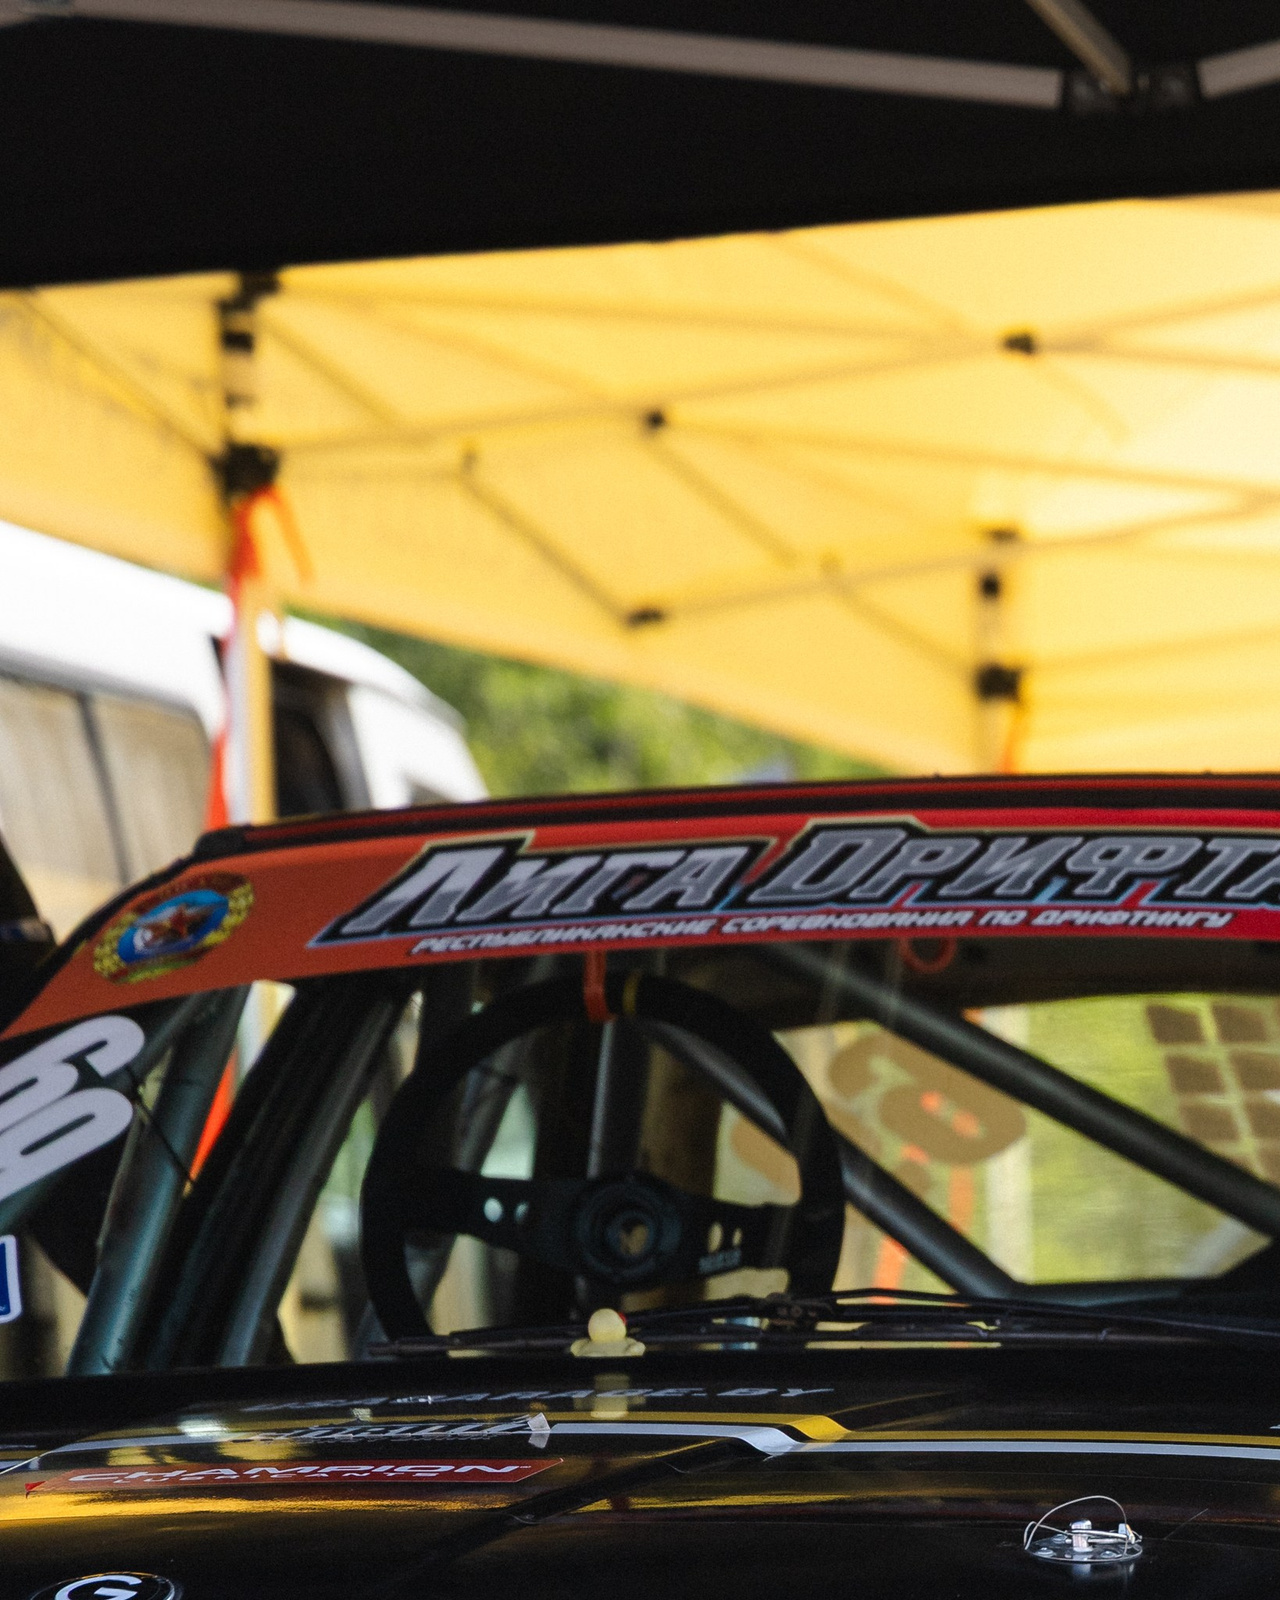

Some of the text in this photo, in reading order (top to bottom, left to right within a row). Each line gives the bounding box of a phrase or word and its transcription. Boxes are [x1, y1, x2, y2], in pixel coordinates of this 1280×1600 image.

[721, 910, 975, 934] СОРЕВНОВАНИЯ
[978, 909, 1028, 927] ПО
[1031, 909, 1234, 929] ДРИФТИНГУ
[68, 1464, 523, 1483] CHAMPION
[112, 1472, 440, 1485] LUBRICANTS
